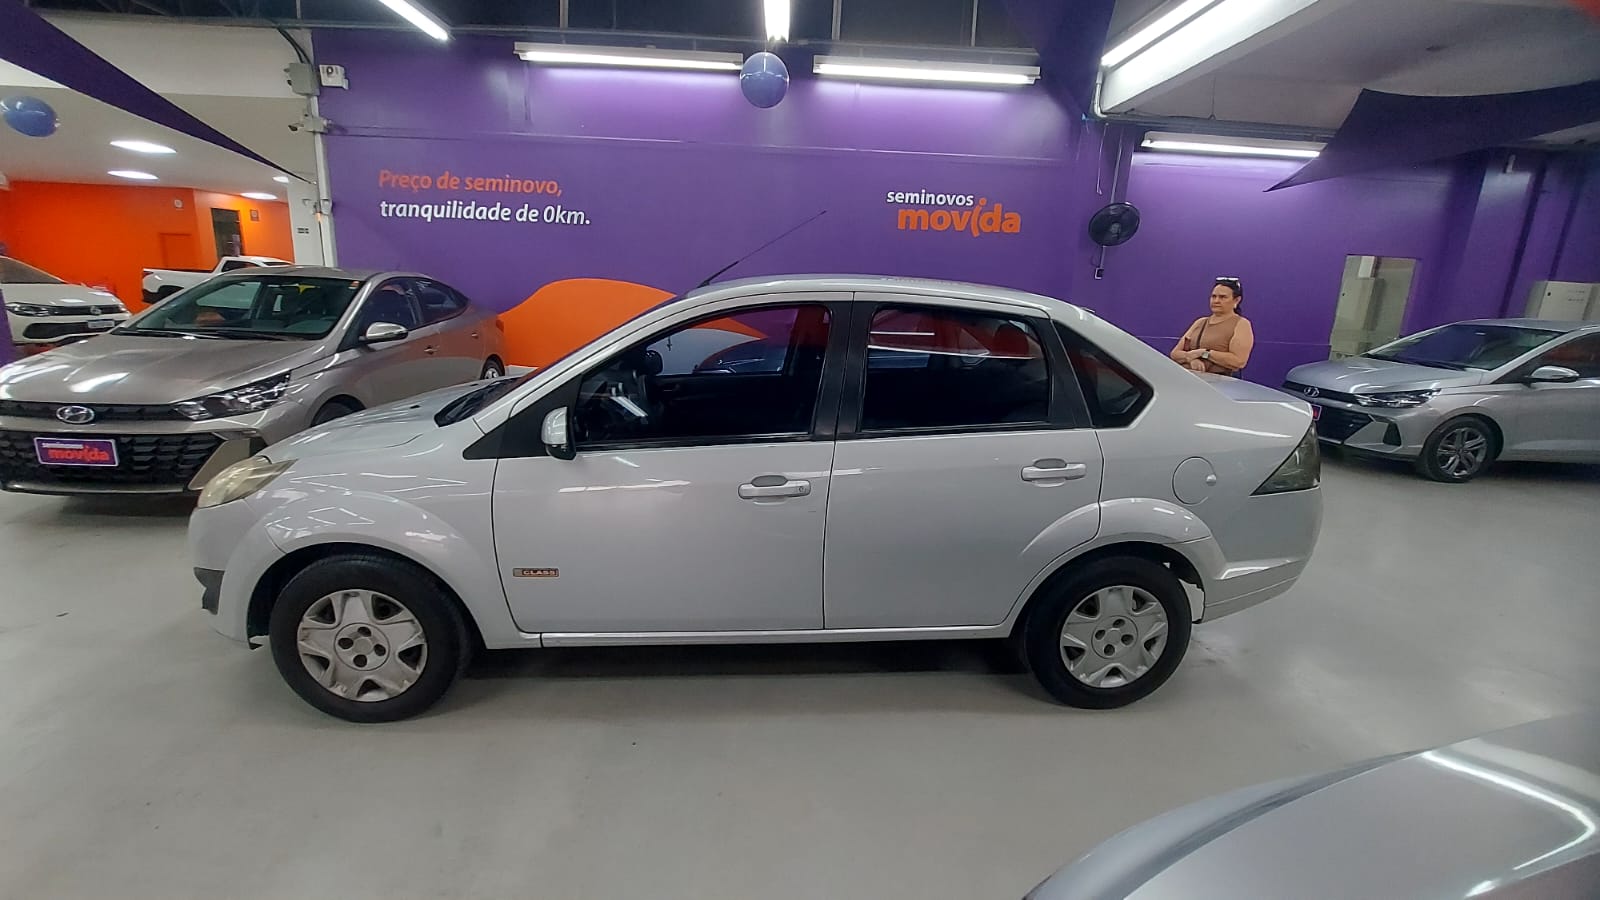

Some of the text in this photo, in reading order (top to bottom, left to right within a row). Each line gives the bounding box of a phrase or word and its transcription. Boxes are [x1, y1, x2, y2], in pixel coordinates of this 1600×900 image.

[378, 170, 563, 197] Preço de seminovo,
[886, 189, 975, 206] seminovos
[379, 201, 511, 222] tranquilidade
[515, 203, 539, 222] de
[897, 197, 1021, 238] movida
